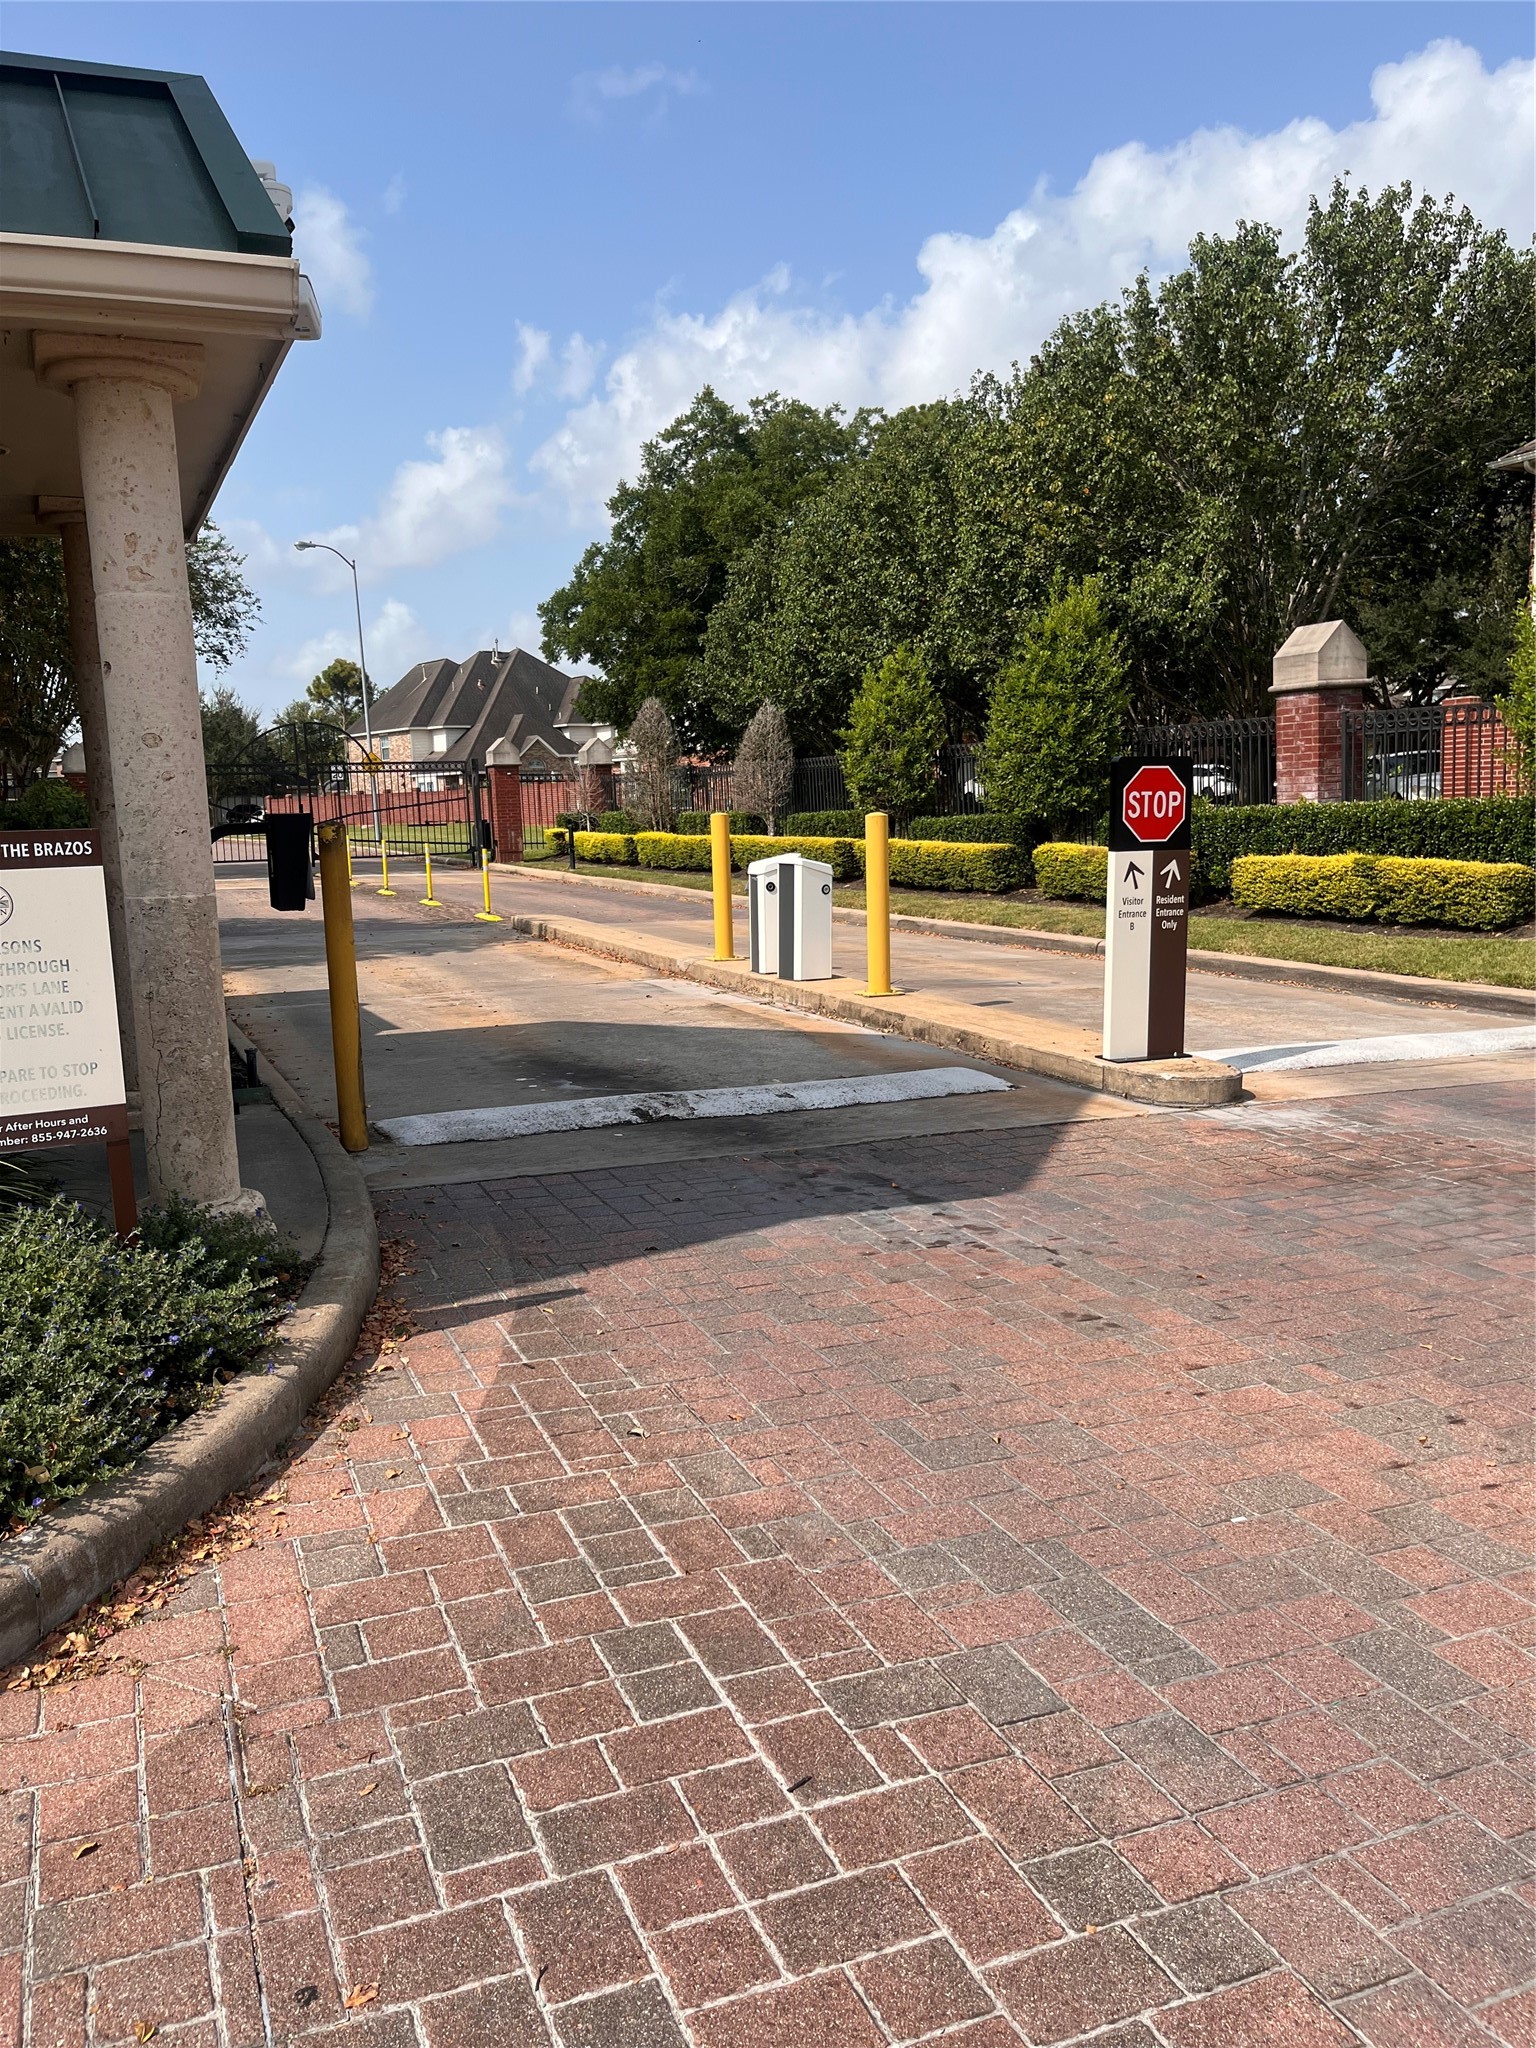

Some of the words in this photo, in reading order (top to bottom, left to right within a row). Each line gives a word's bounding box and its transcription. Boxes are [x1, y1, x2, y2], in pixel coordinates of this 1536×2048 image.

[1127, 790, 1182, 819] STOP
[0, 843, 30, 858] THE
[33, 840, 93, 857] BRAZOS
[1122, 897, 1144, 905] Visitor
[1155, 895, 1185, 904] Resident
[1118, 910, 1147, 918] Entrance
[1155, 908, 1184, 917] Entrance
[1129, 922, 1135, 930] B
[1161, 920, 1178, 931] Only
[0, 939, 42, 955] SONS
[0, 959, 70, 976] THROUGH
[33, 980, 70, 995] LANE
[0, 1004, 25, 1019] ENT
[29, 1003, 39, 1018] A
[40, 1000, 84, 1016] VALID
[6, 1022, 69, 1040] LICENSE.
[0, 1068, 36, 1083] PARE
[40, 1065, 58, 1079] TO
[63, 1062, 98, 1078] STOP
[5, 1121, 33, 1132] After
[35, 1119, 66, 1129] Hours
[68, 1114, 89, 1125] and
[31, 1126, 108, 1143] 855-947-2636
